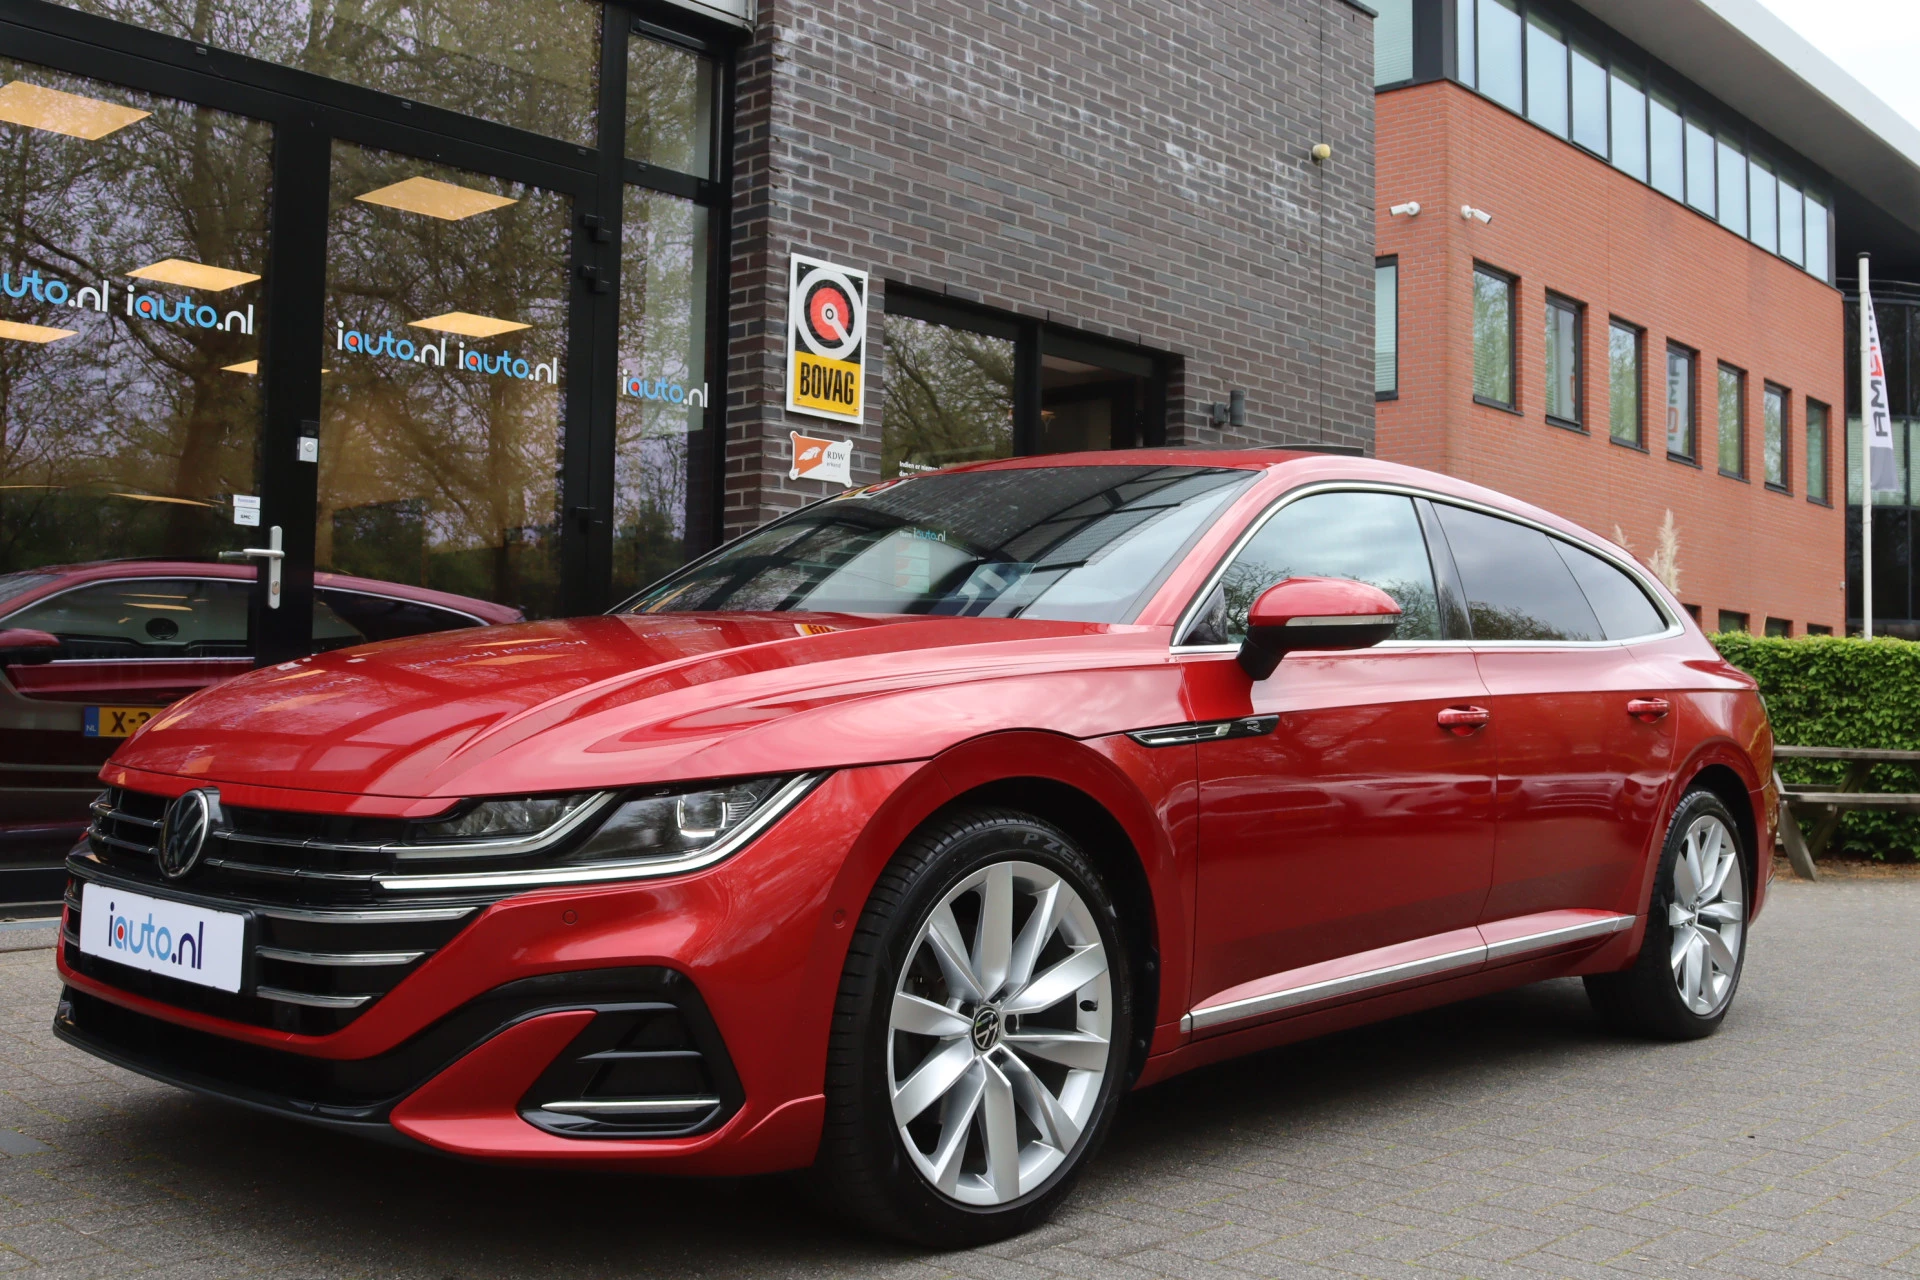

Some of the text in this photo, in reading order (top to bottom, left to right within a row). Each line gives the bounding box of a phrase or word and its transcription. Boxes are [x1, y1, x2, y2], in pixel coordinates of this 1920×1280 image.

[0, 270, 254, 335] uto.nl iauto.nl
[337, 321, 558, 385] iauto.nl iauto.nl
[622, 369, 708, 408] iauto.nl
[800, 362, 854, 405] BOVAG
[827, 451, 845, 460] RDW
[913, 527, 946, 542] iauto.nl
[108, 901, 204, 970] iauto.nl
